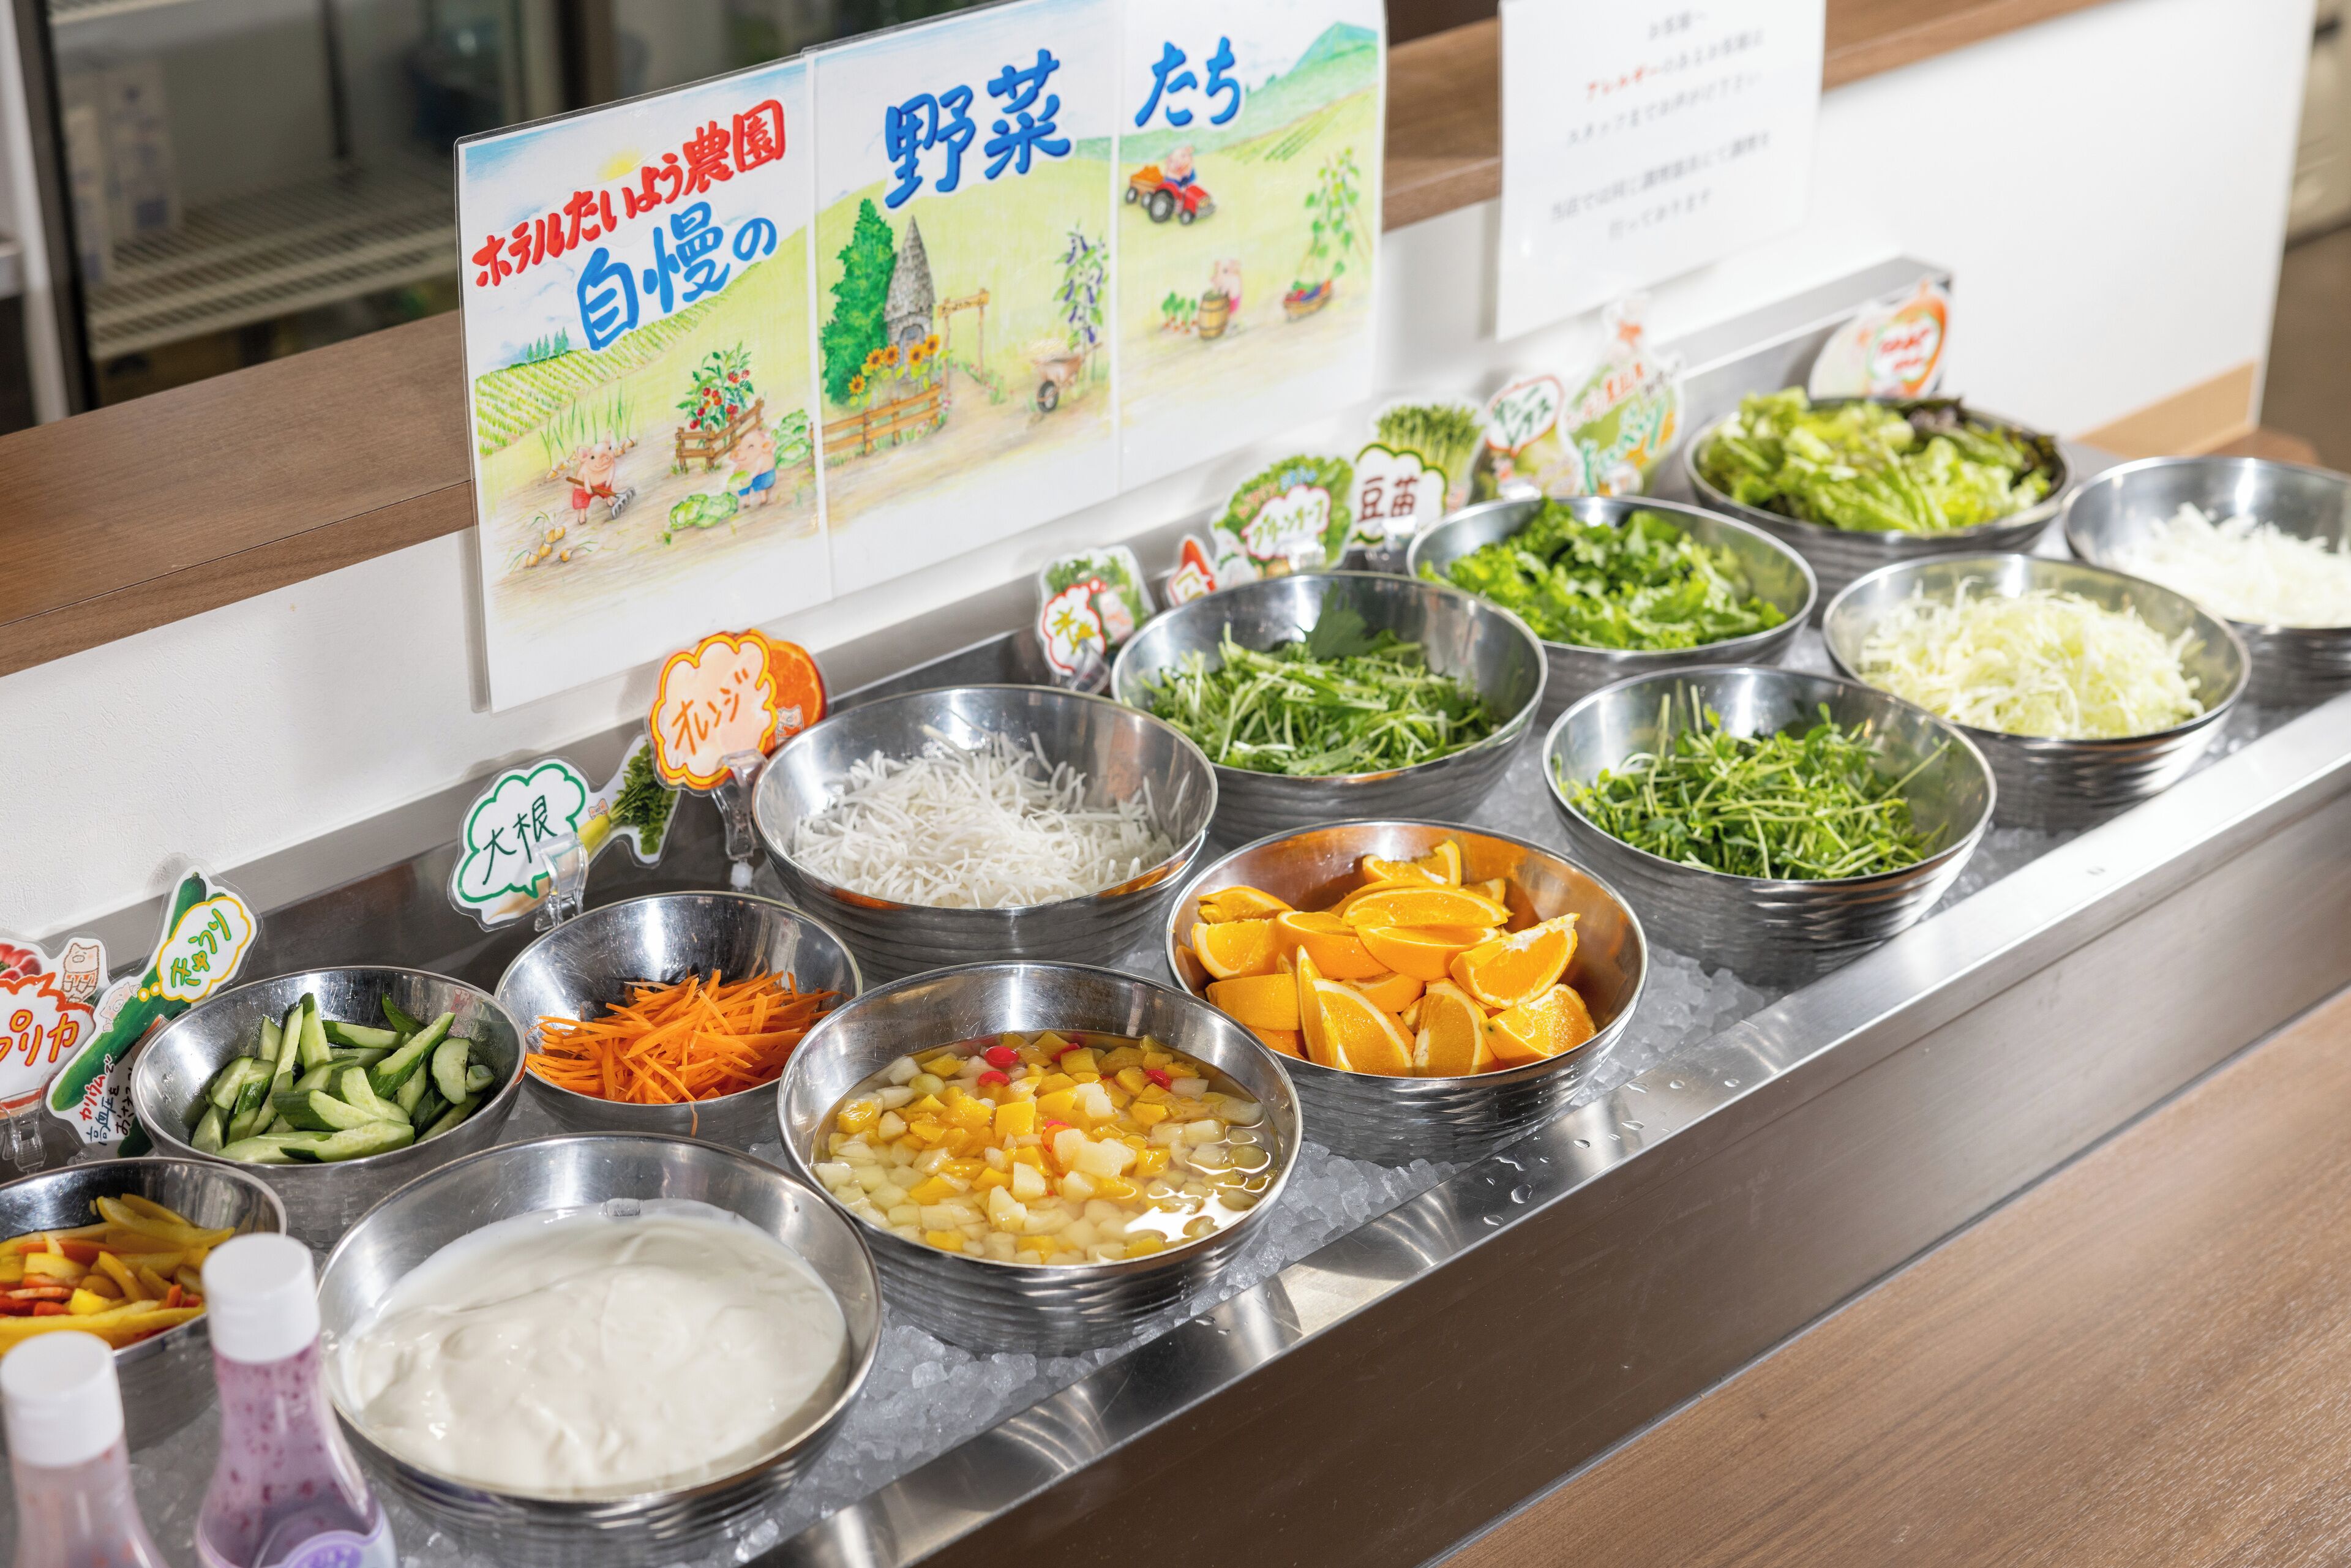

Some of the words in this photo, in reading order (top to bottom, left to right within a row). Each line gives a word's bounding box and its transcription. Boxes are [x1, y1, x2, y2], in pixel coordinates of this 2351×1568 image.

[1135, 36, 1241, 127] たち
[885, 48, 1071, 209] 野菜
[472, 99, 786, 287] ホテルたいよう農園
[577, 201, 777, 351] 自慢の
[1357, 475, 1418, 522] 豆苗
[672, 668, 749, 755] オレンジ
[483, 795, 557, 885] 大根
[170, 908, 232, 988] きゅうり
[80, 1054, 114, 1122] カリウムで
[86, 1085, 120, 1146] 高血圧を
